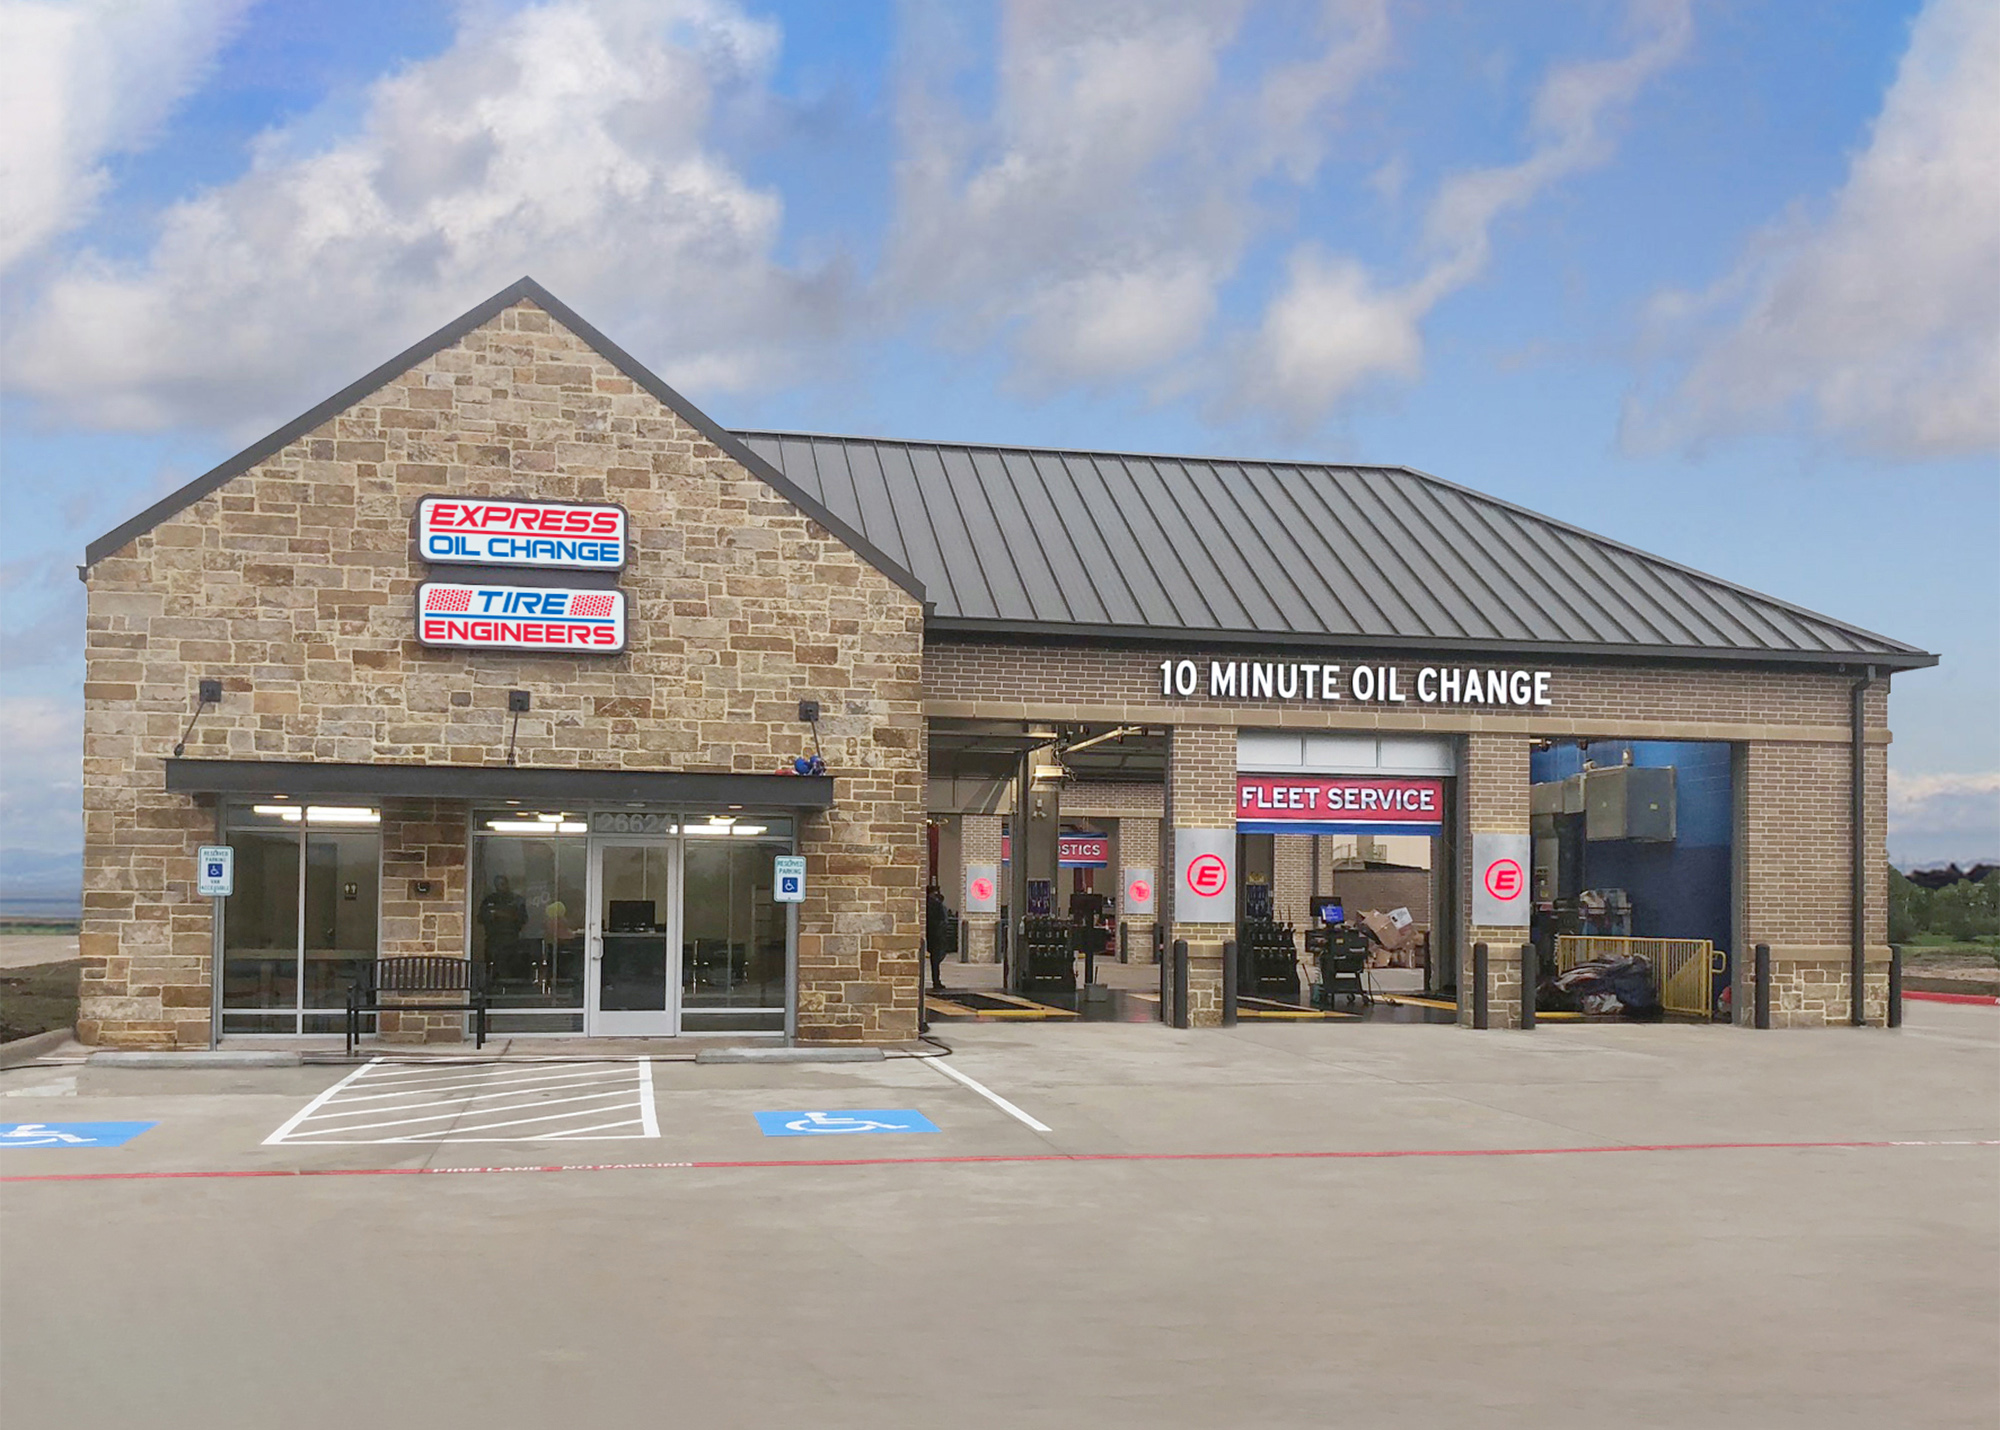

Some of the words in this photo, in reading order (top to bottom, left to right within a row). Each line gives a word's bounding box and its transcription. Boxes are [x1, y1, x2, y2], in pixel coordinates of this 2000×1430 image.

[428, 503, 619, 533] EXPRESS
[428, 535, 481, 557] OIL
[487, 537, 620, 562] CHANGE
[477, 590, 569, 615] TIRE
[424, 620, 617, 645] ENGINEERS
[1160, 659, 1198, 696] 10
[1210, 661, 1341, 700] MINUTE
[1352, 665, 1406, 702] OIL
[1417, 667, 1553, 706] CHANGE
[1241, 786, 1320, 809] FLEET
[1327, 787, 1436, 811] SERVICE
[601, 813, 673, 833] 26624
[1058, 844, 1101, 856] STICS
